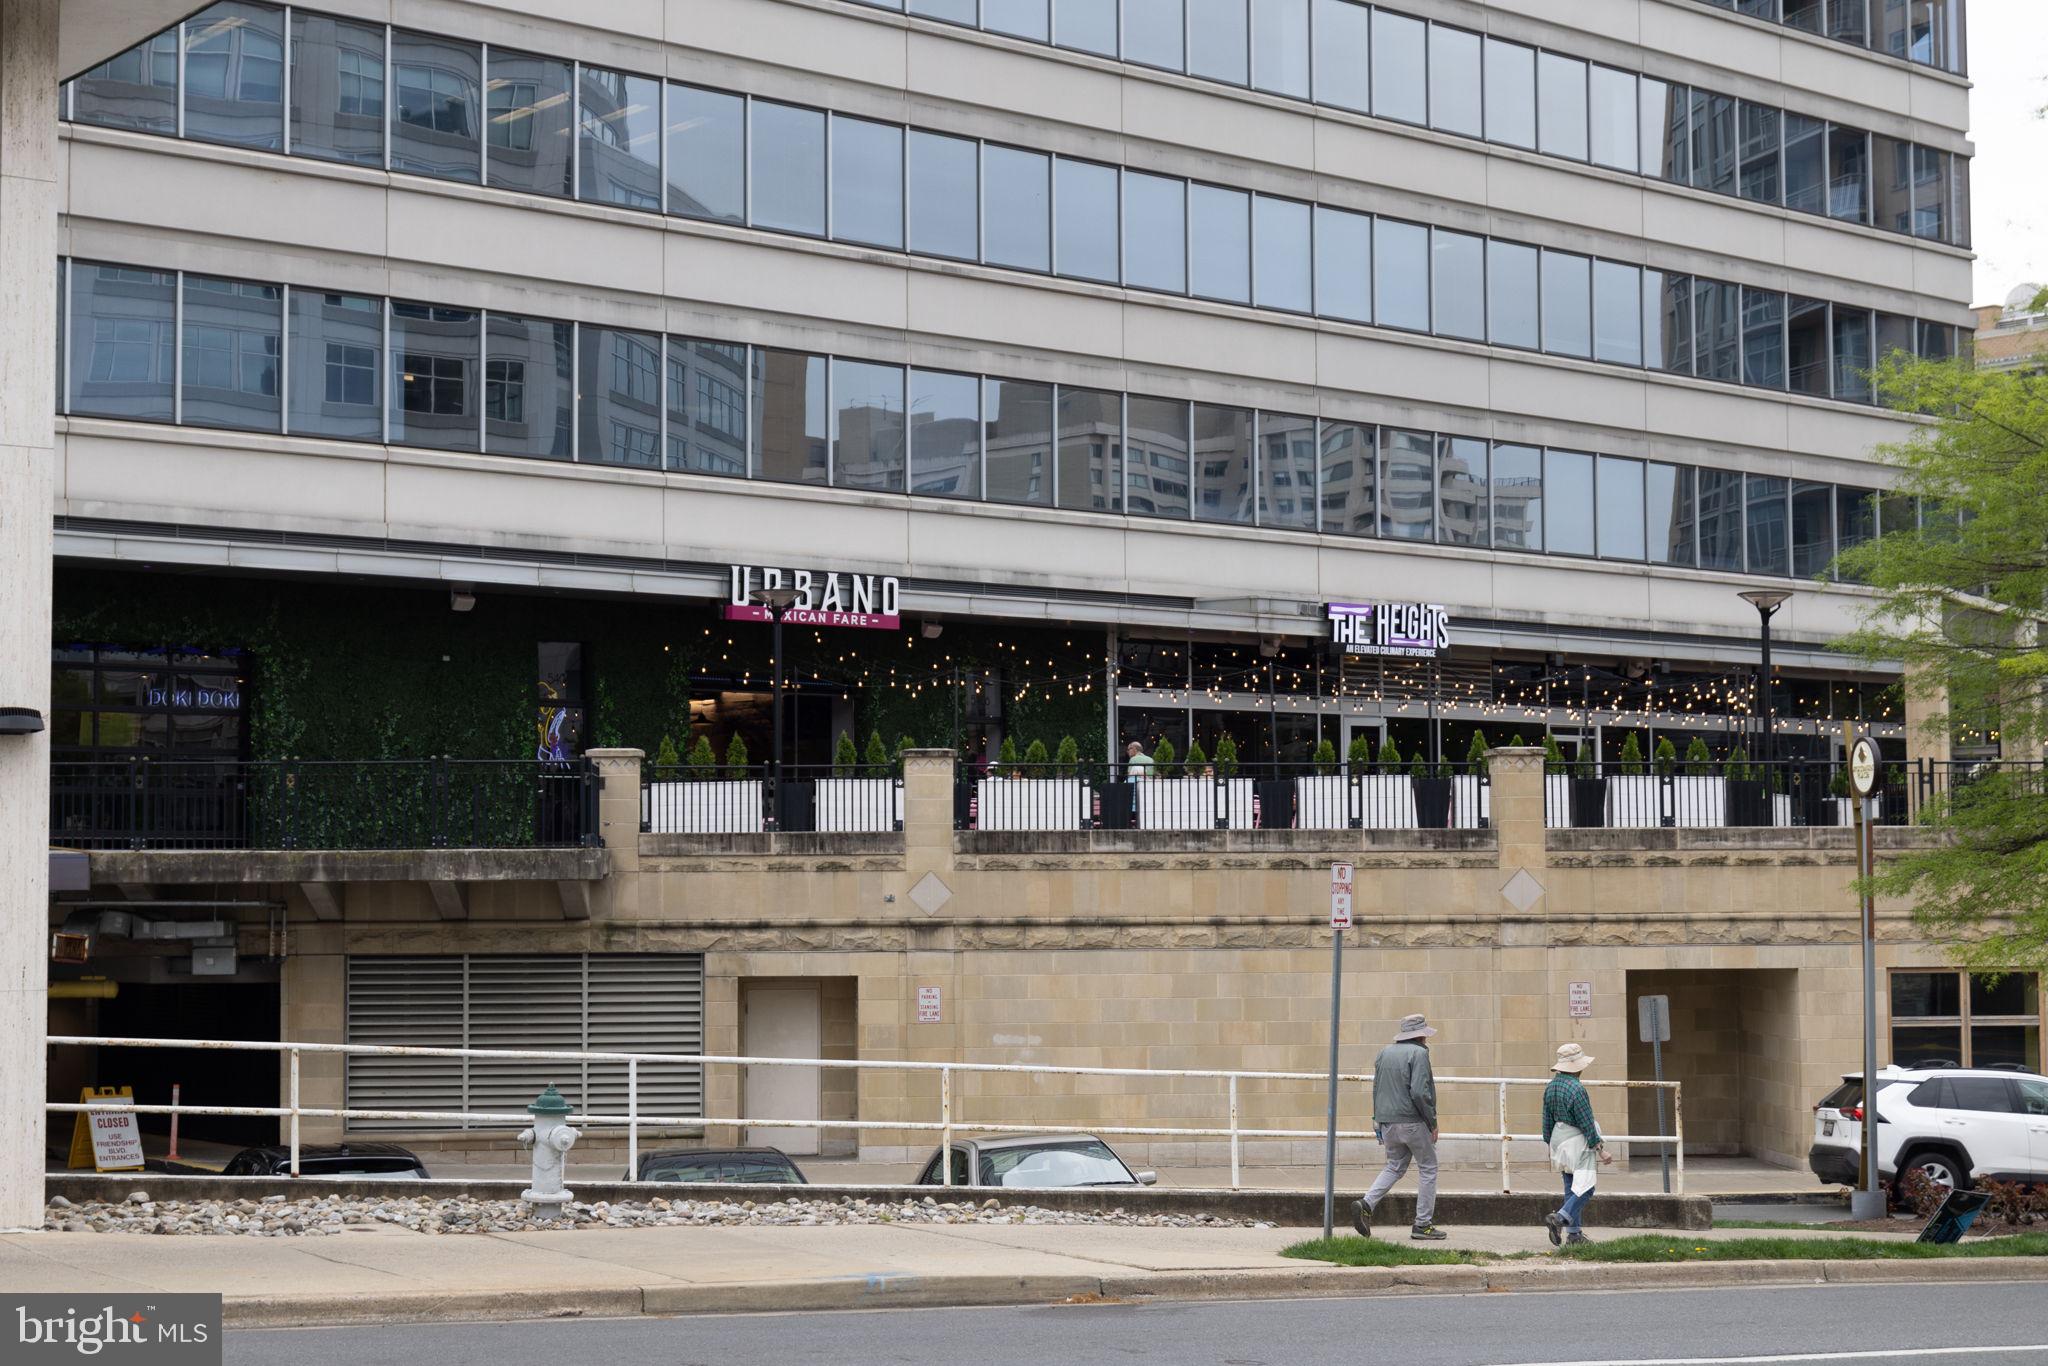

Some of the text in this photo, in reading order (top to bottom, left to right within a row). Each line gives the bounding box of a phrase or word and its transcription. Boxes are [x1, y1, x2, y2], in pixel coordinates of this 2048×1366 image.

[764, 609, 868, 626] MXICAN FARE
[1328, 603, 1449, 649] THE HEIGHTS
[1345, 644, 1437, 658] AN ELEVATED CULINARY EXPERIENCE
[198, 689, 240, 709] DOKI
[1337, 867, 1346, 880] NO
[97, 1116, 129, 1129] CLOSED
[96, 1139, 138, 1148] FRIENDSHIP
[98, 1153, 140, 1162] ENTRANCES
